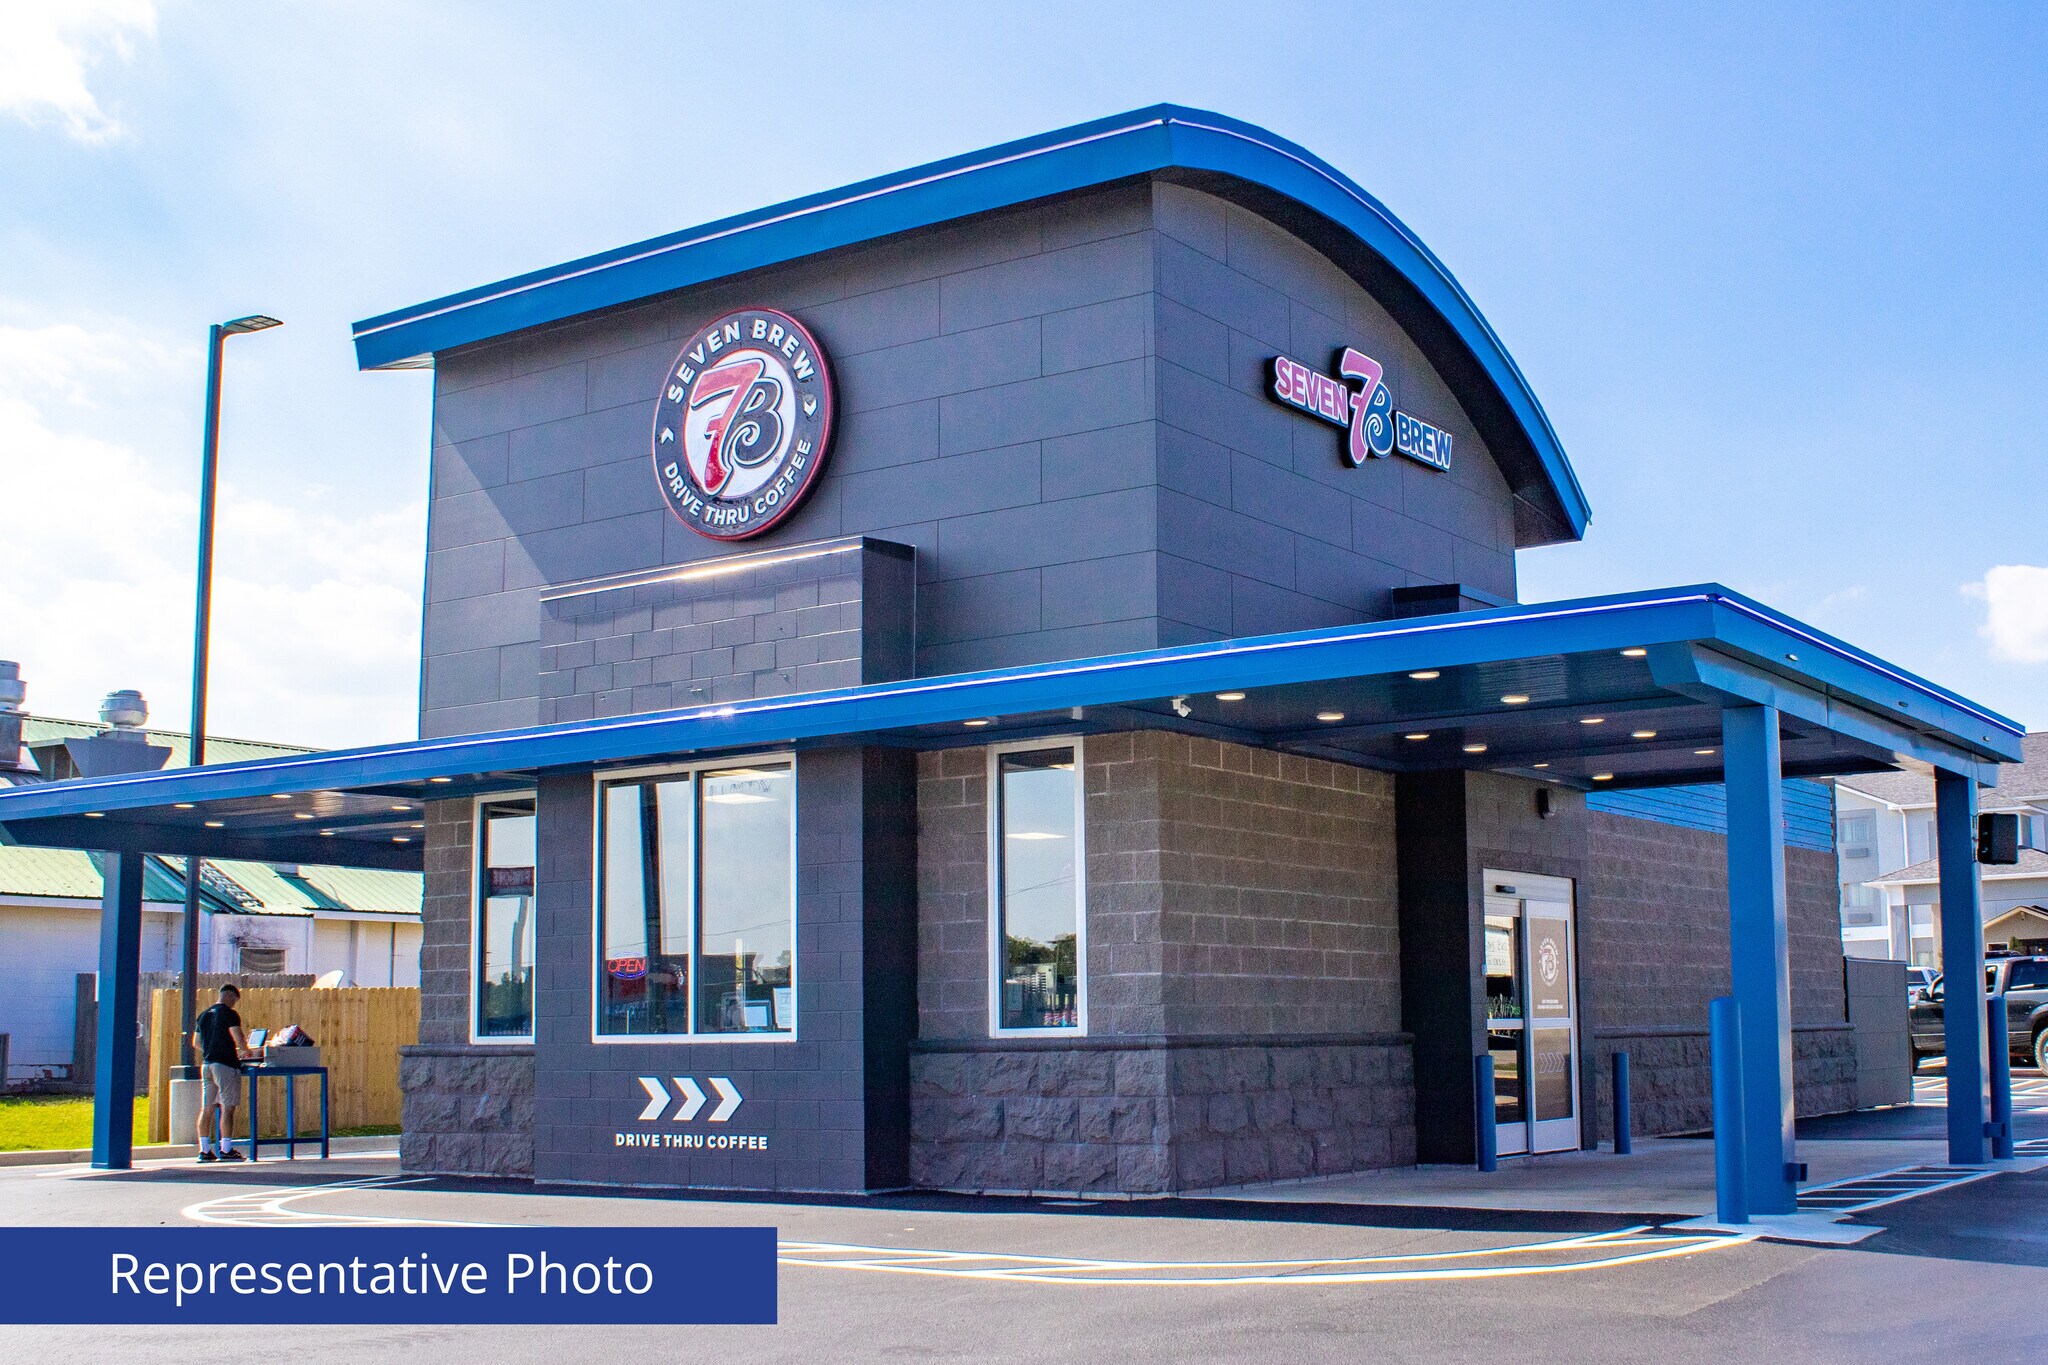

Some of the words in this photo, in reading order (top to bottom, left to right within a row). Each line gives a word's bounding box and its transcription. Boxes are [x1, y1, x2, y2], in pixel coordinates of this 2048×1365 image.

[667, 320, 741, 404] SEVEN
[752, 319, 815, 381] BREW
[1275, 357, 1348, 425] SEVEN
[1396, 411, 1452, 470] BREW
[665, 462, 704, 516] DRIVE
[705, 505, 750, 526] THRU
[754, 439, 812, 515] COFFEE
[607, 957, 646, 973] OPEN
[615, 1133, 660, 1147] DRIVE
[664, 1134, 704, 1149] THRU
[707, 1135, 769, 1151] COFFEE
